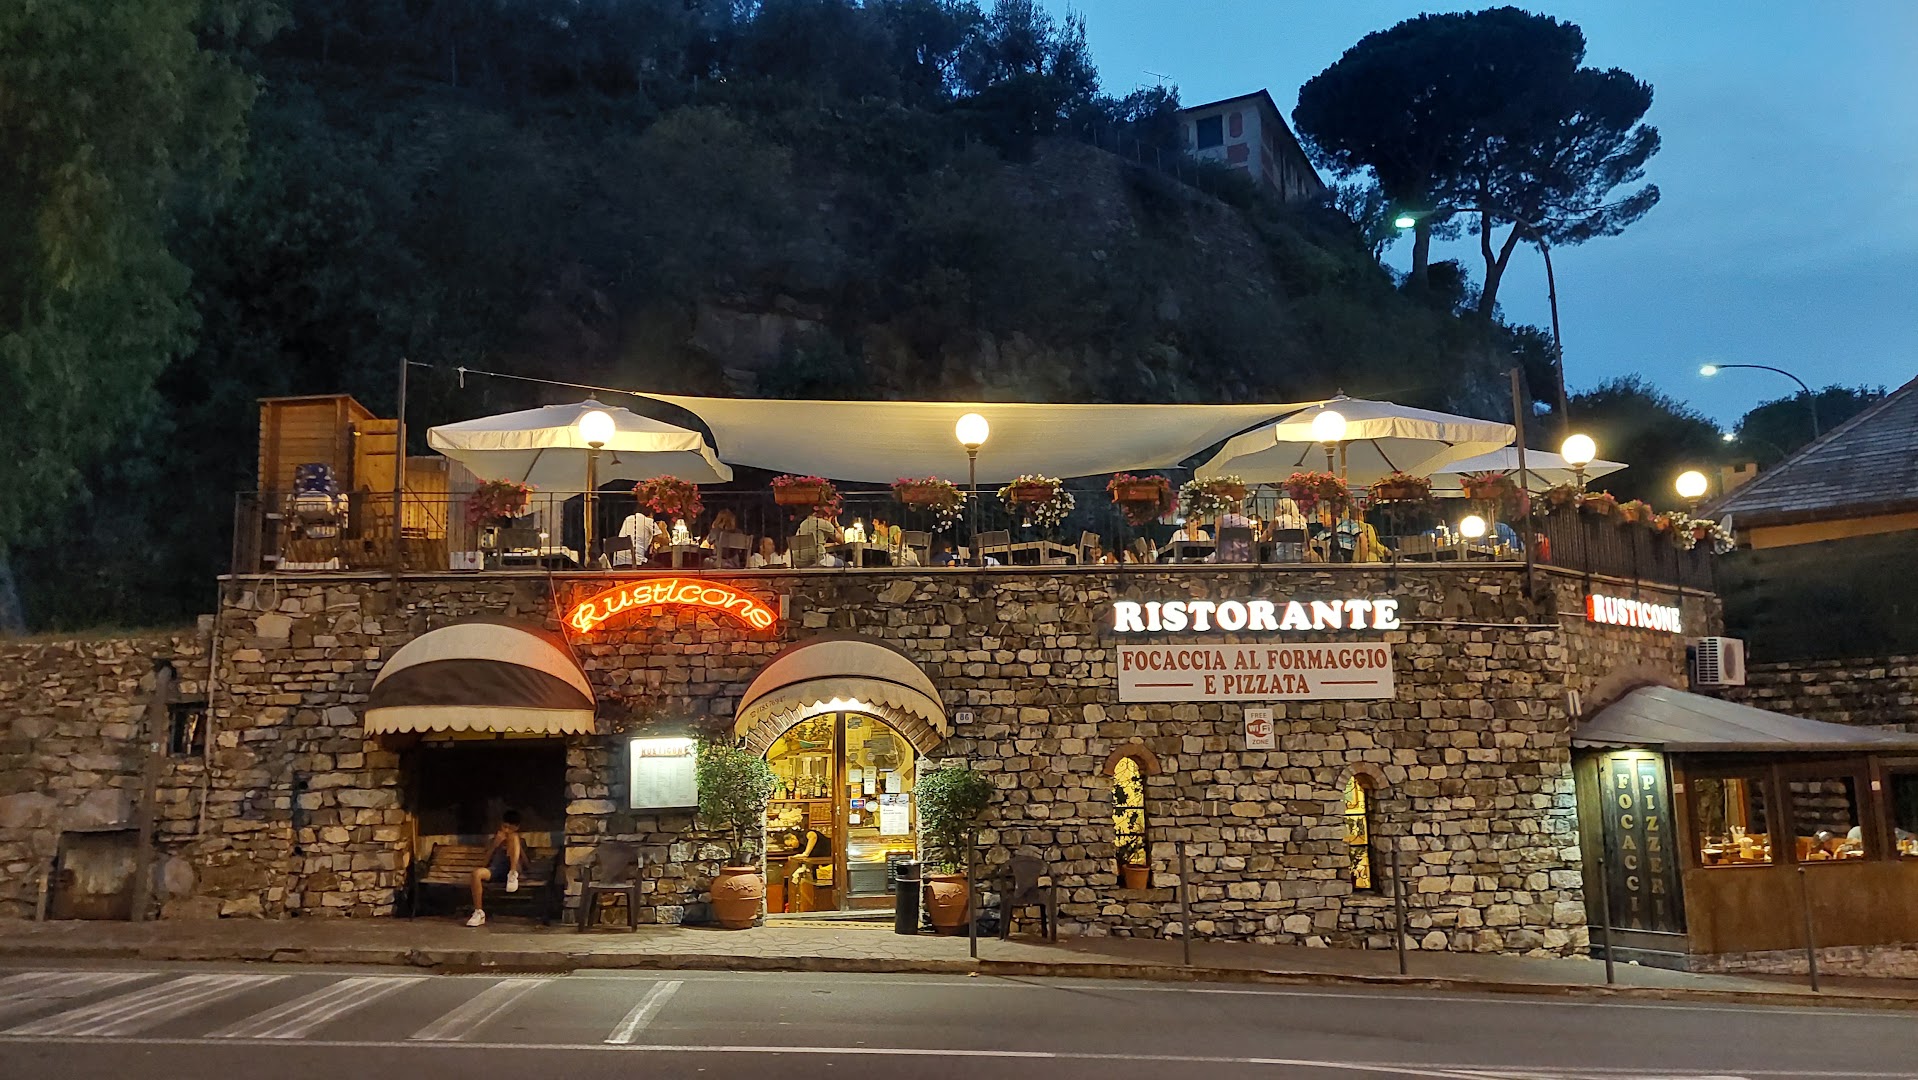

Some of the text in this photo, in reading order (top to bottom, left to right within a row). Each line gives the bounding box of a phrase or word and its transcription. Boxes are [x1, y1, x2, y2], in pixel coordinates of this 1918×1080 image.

[571, 579, 772, 634] Rusticone
[1112, 599, 1400, 632] RISTORANTE
[1592, 594, 1682, 634] RUSTICONE
[1122, 648, 1388, 671] FOCACCIA AL FORMAGGIO
[1204, 673, 1310, 695] E PIZZATA
[960, 713, 970, 721] 86
[1616, 773, 1643, 930] FOCACCIA
[1641, 774, 1667, 932] PIZZERIA
